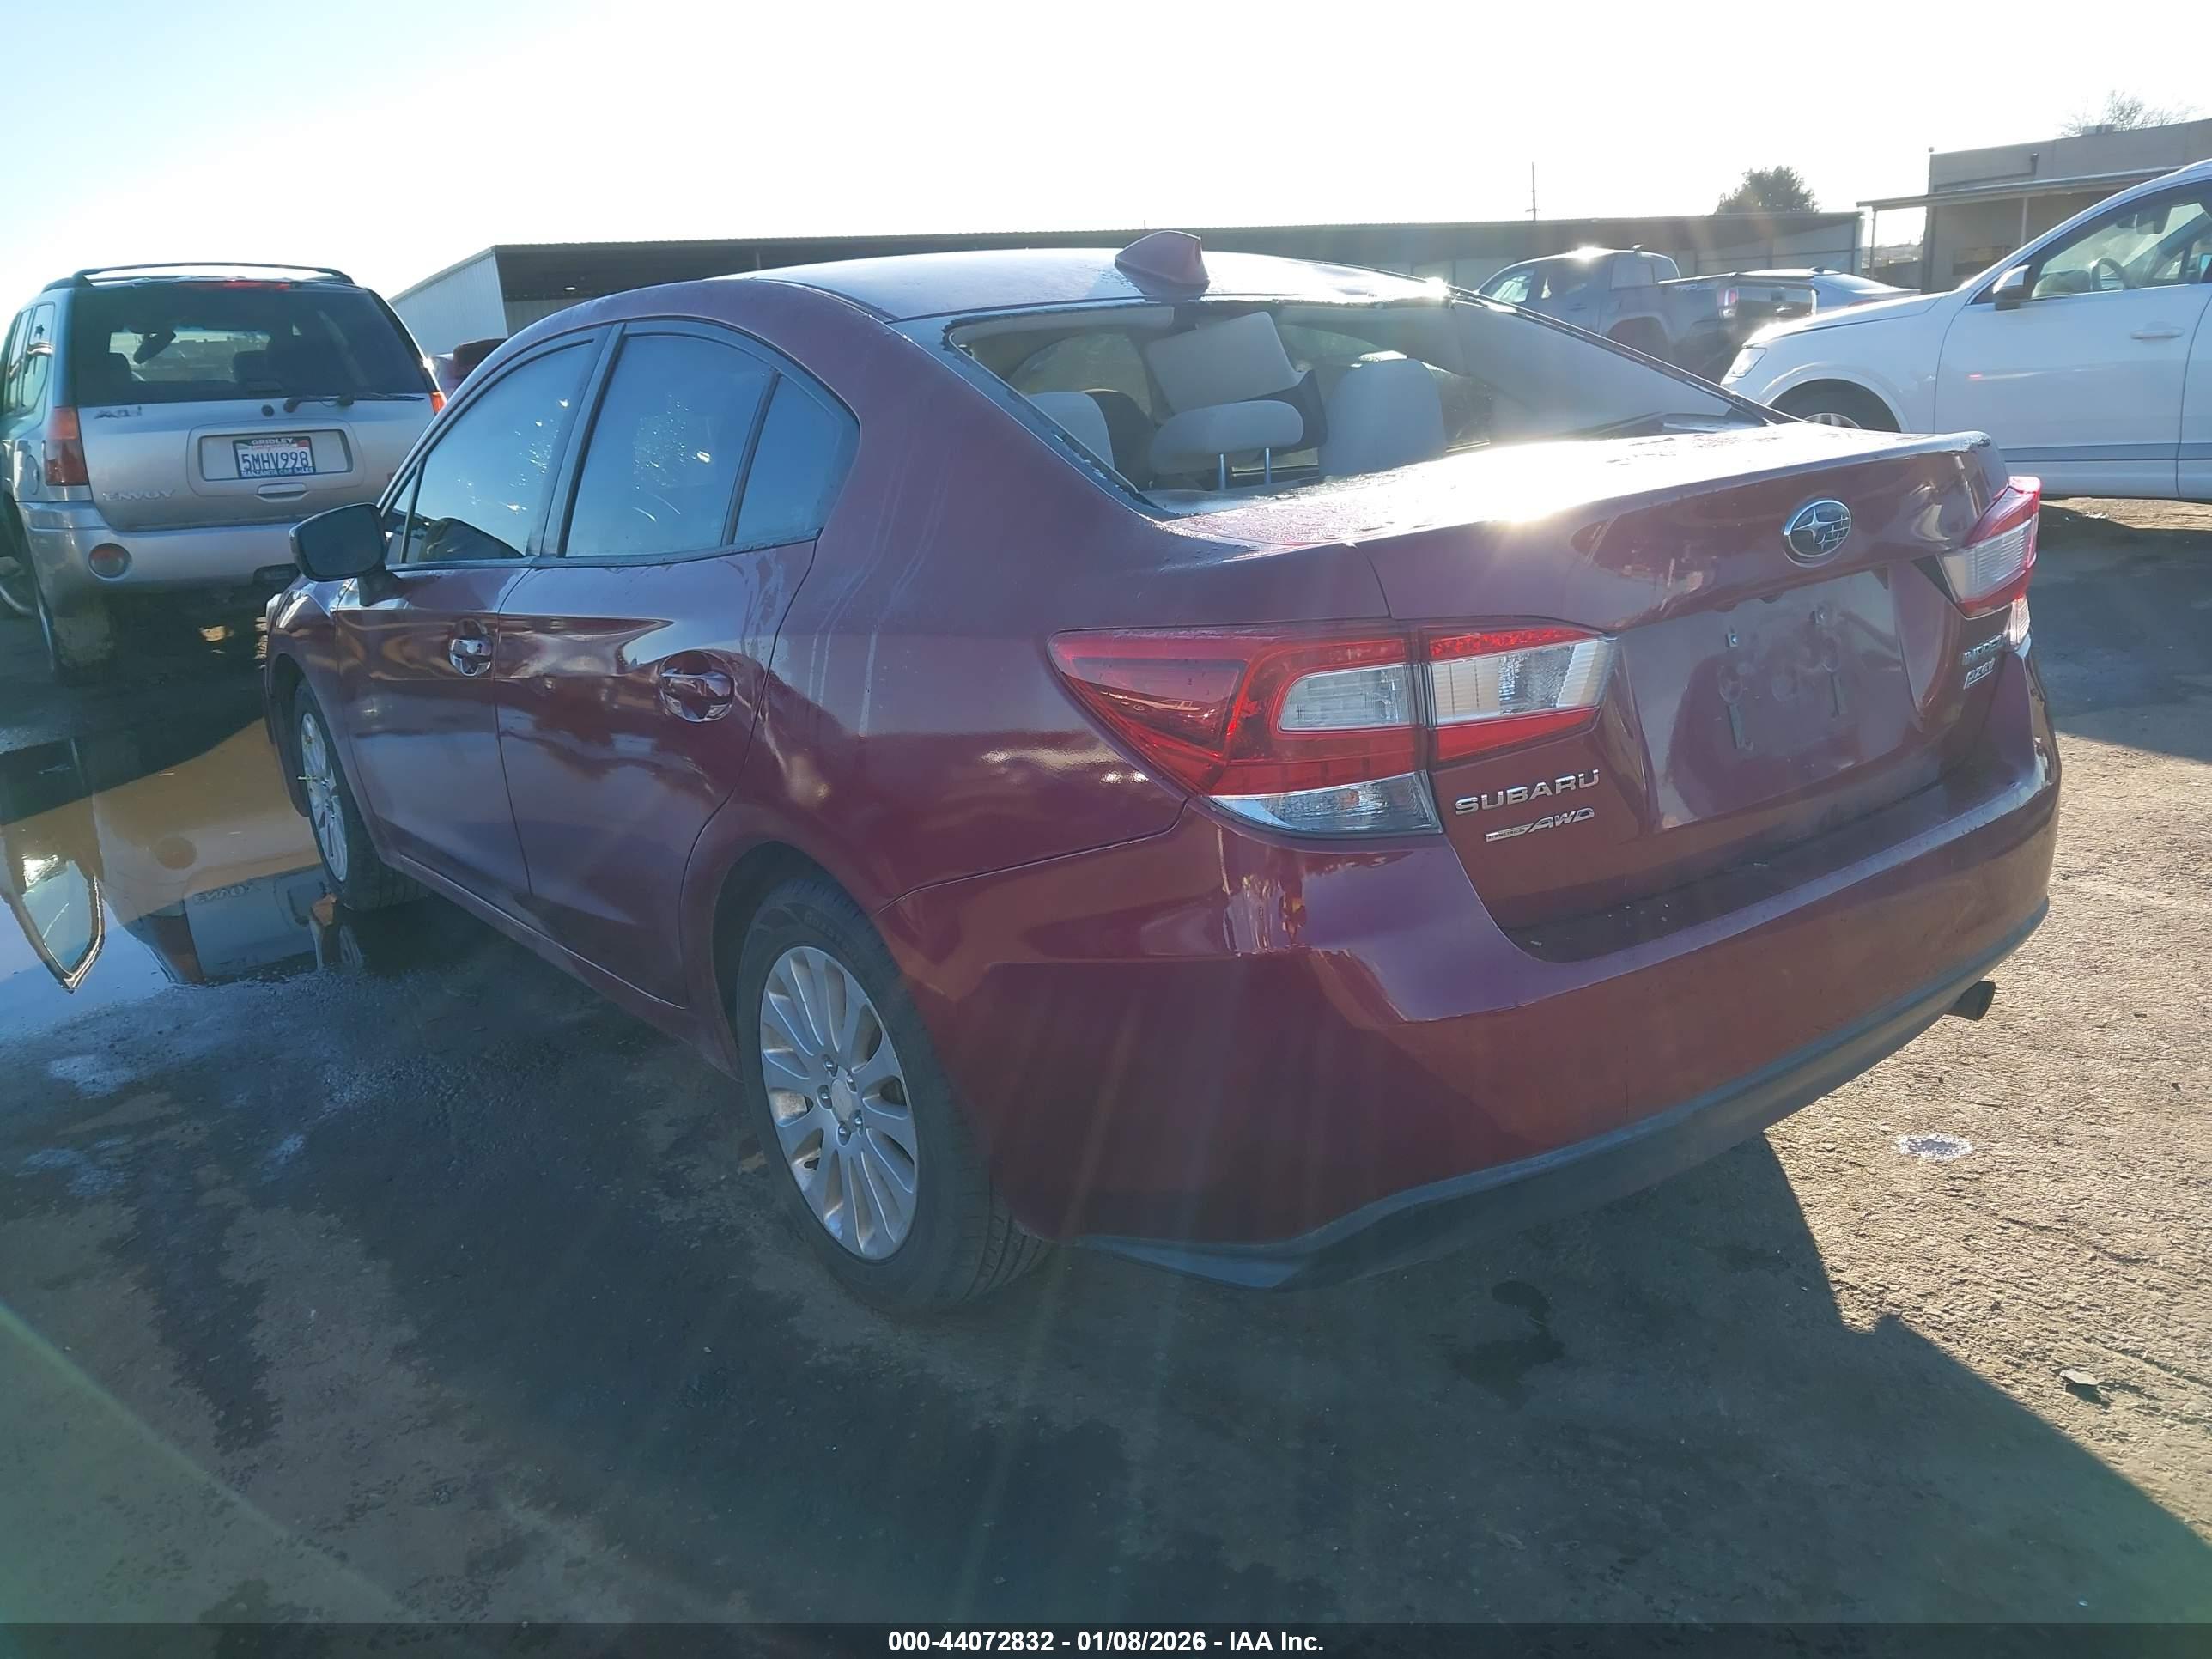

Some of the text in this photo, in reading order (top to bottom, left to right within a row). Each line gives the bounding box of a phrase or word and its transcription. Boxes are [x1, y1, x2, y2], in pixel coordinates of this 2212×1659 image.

[241, 451, 309, 470] 5MHV998
[102, 489, 176, 502] ENVOY
[1455, 769, 1600, 816] SUBARU
[1528, 807, 1595, 833] AWD
